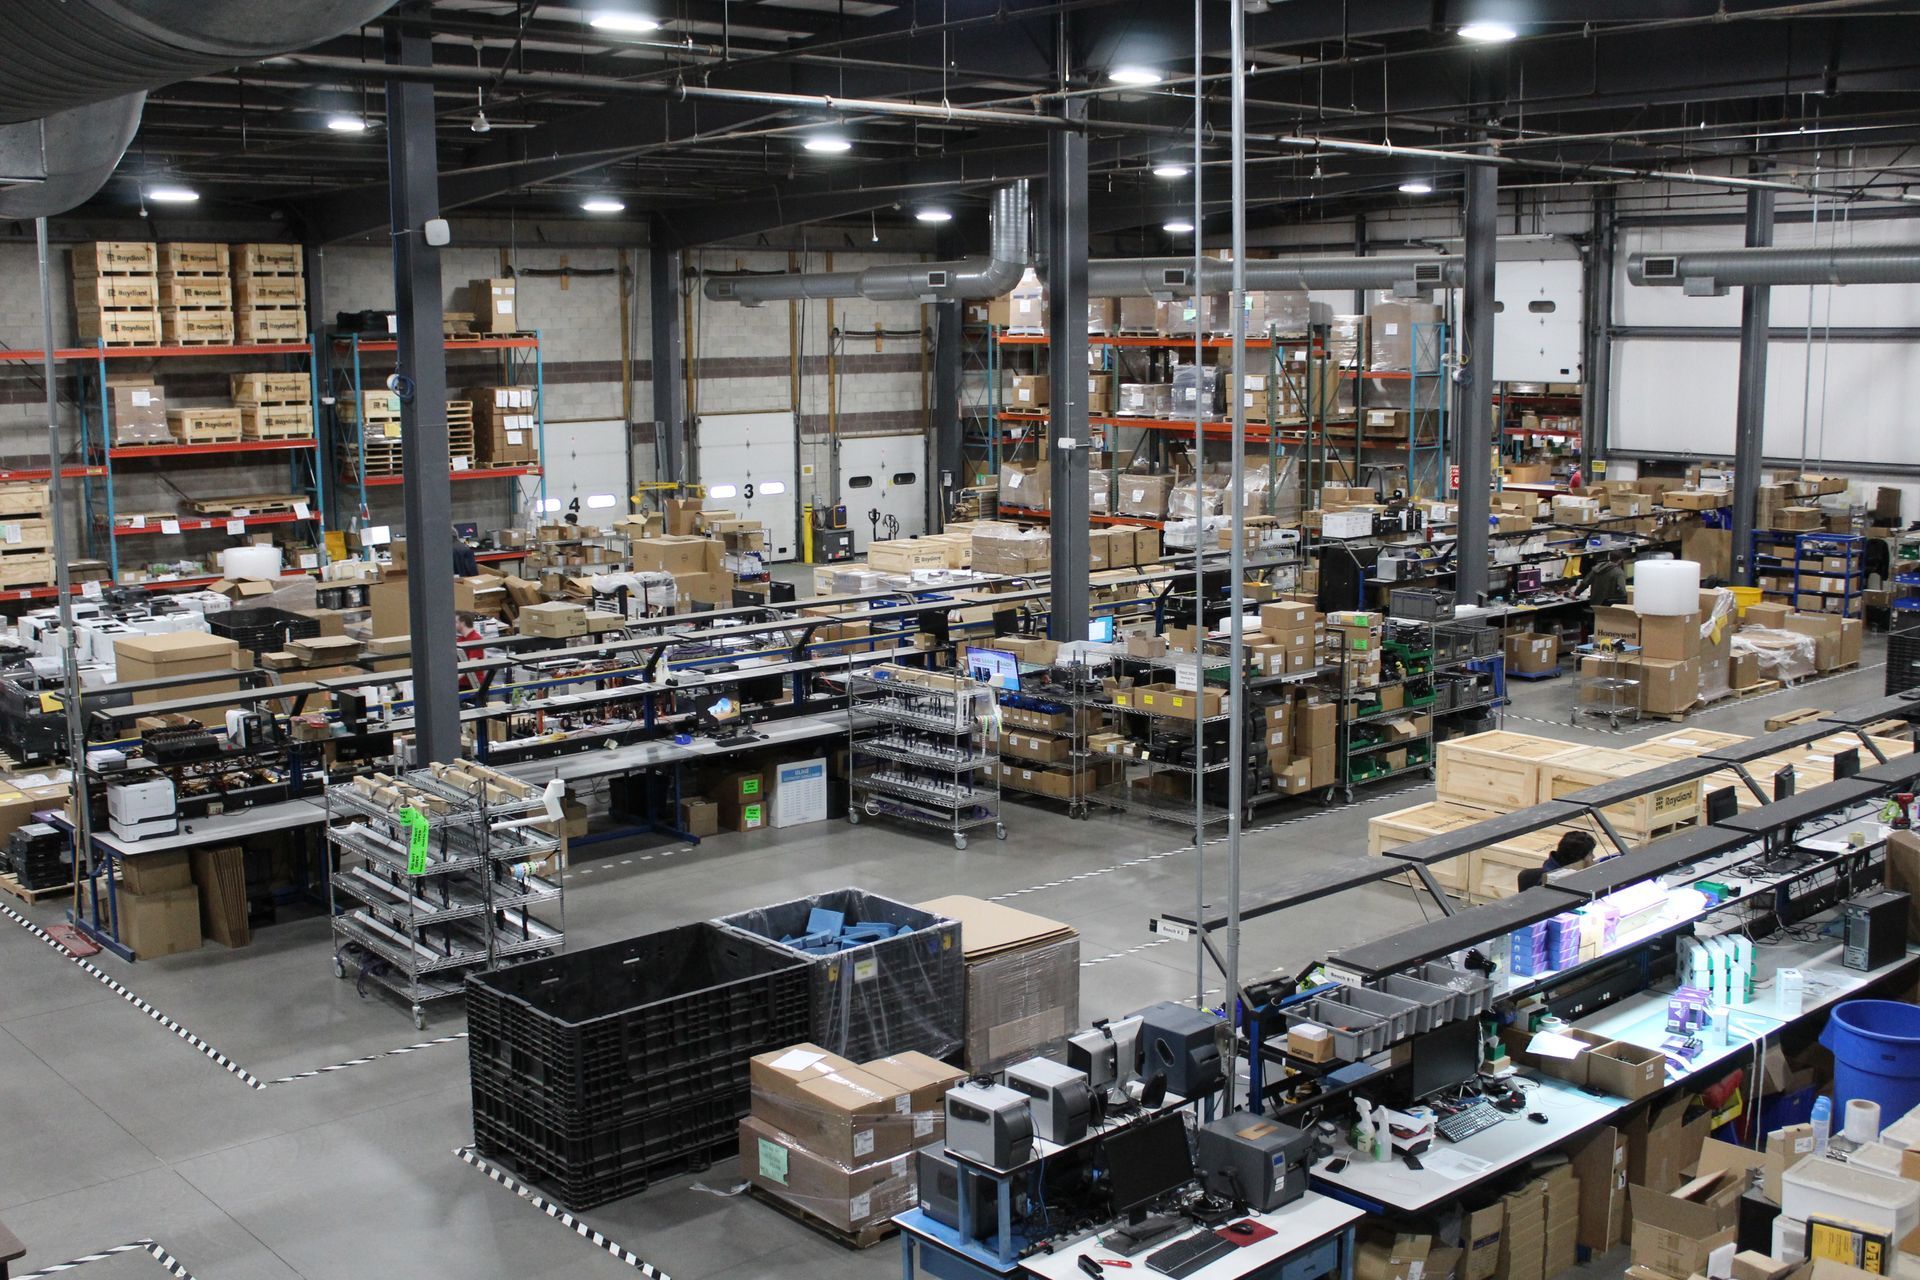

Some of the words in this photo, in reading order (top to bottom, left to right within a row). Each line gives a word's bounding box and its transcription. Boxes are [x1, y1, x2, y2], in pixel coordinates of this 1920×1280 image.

[744, 483, 754, 499] 3
[569, 497, 580, 513] 4
[1597, 629, 1636, 640] Honeywell
[1665, 789, 1693, 807] Raydiant
